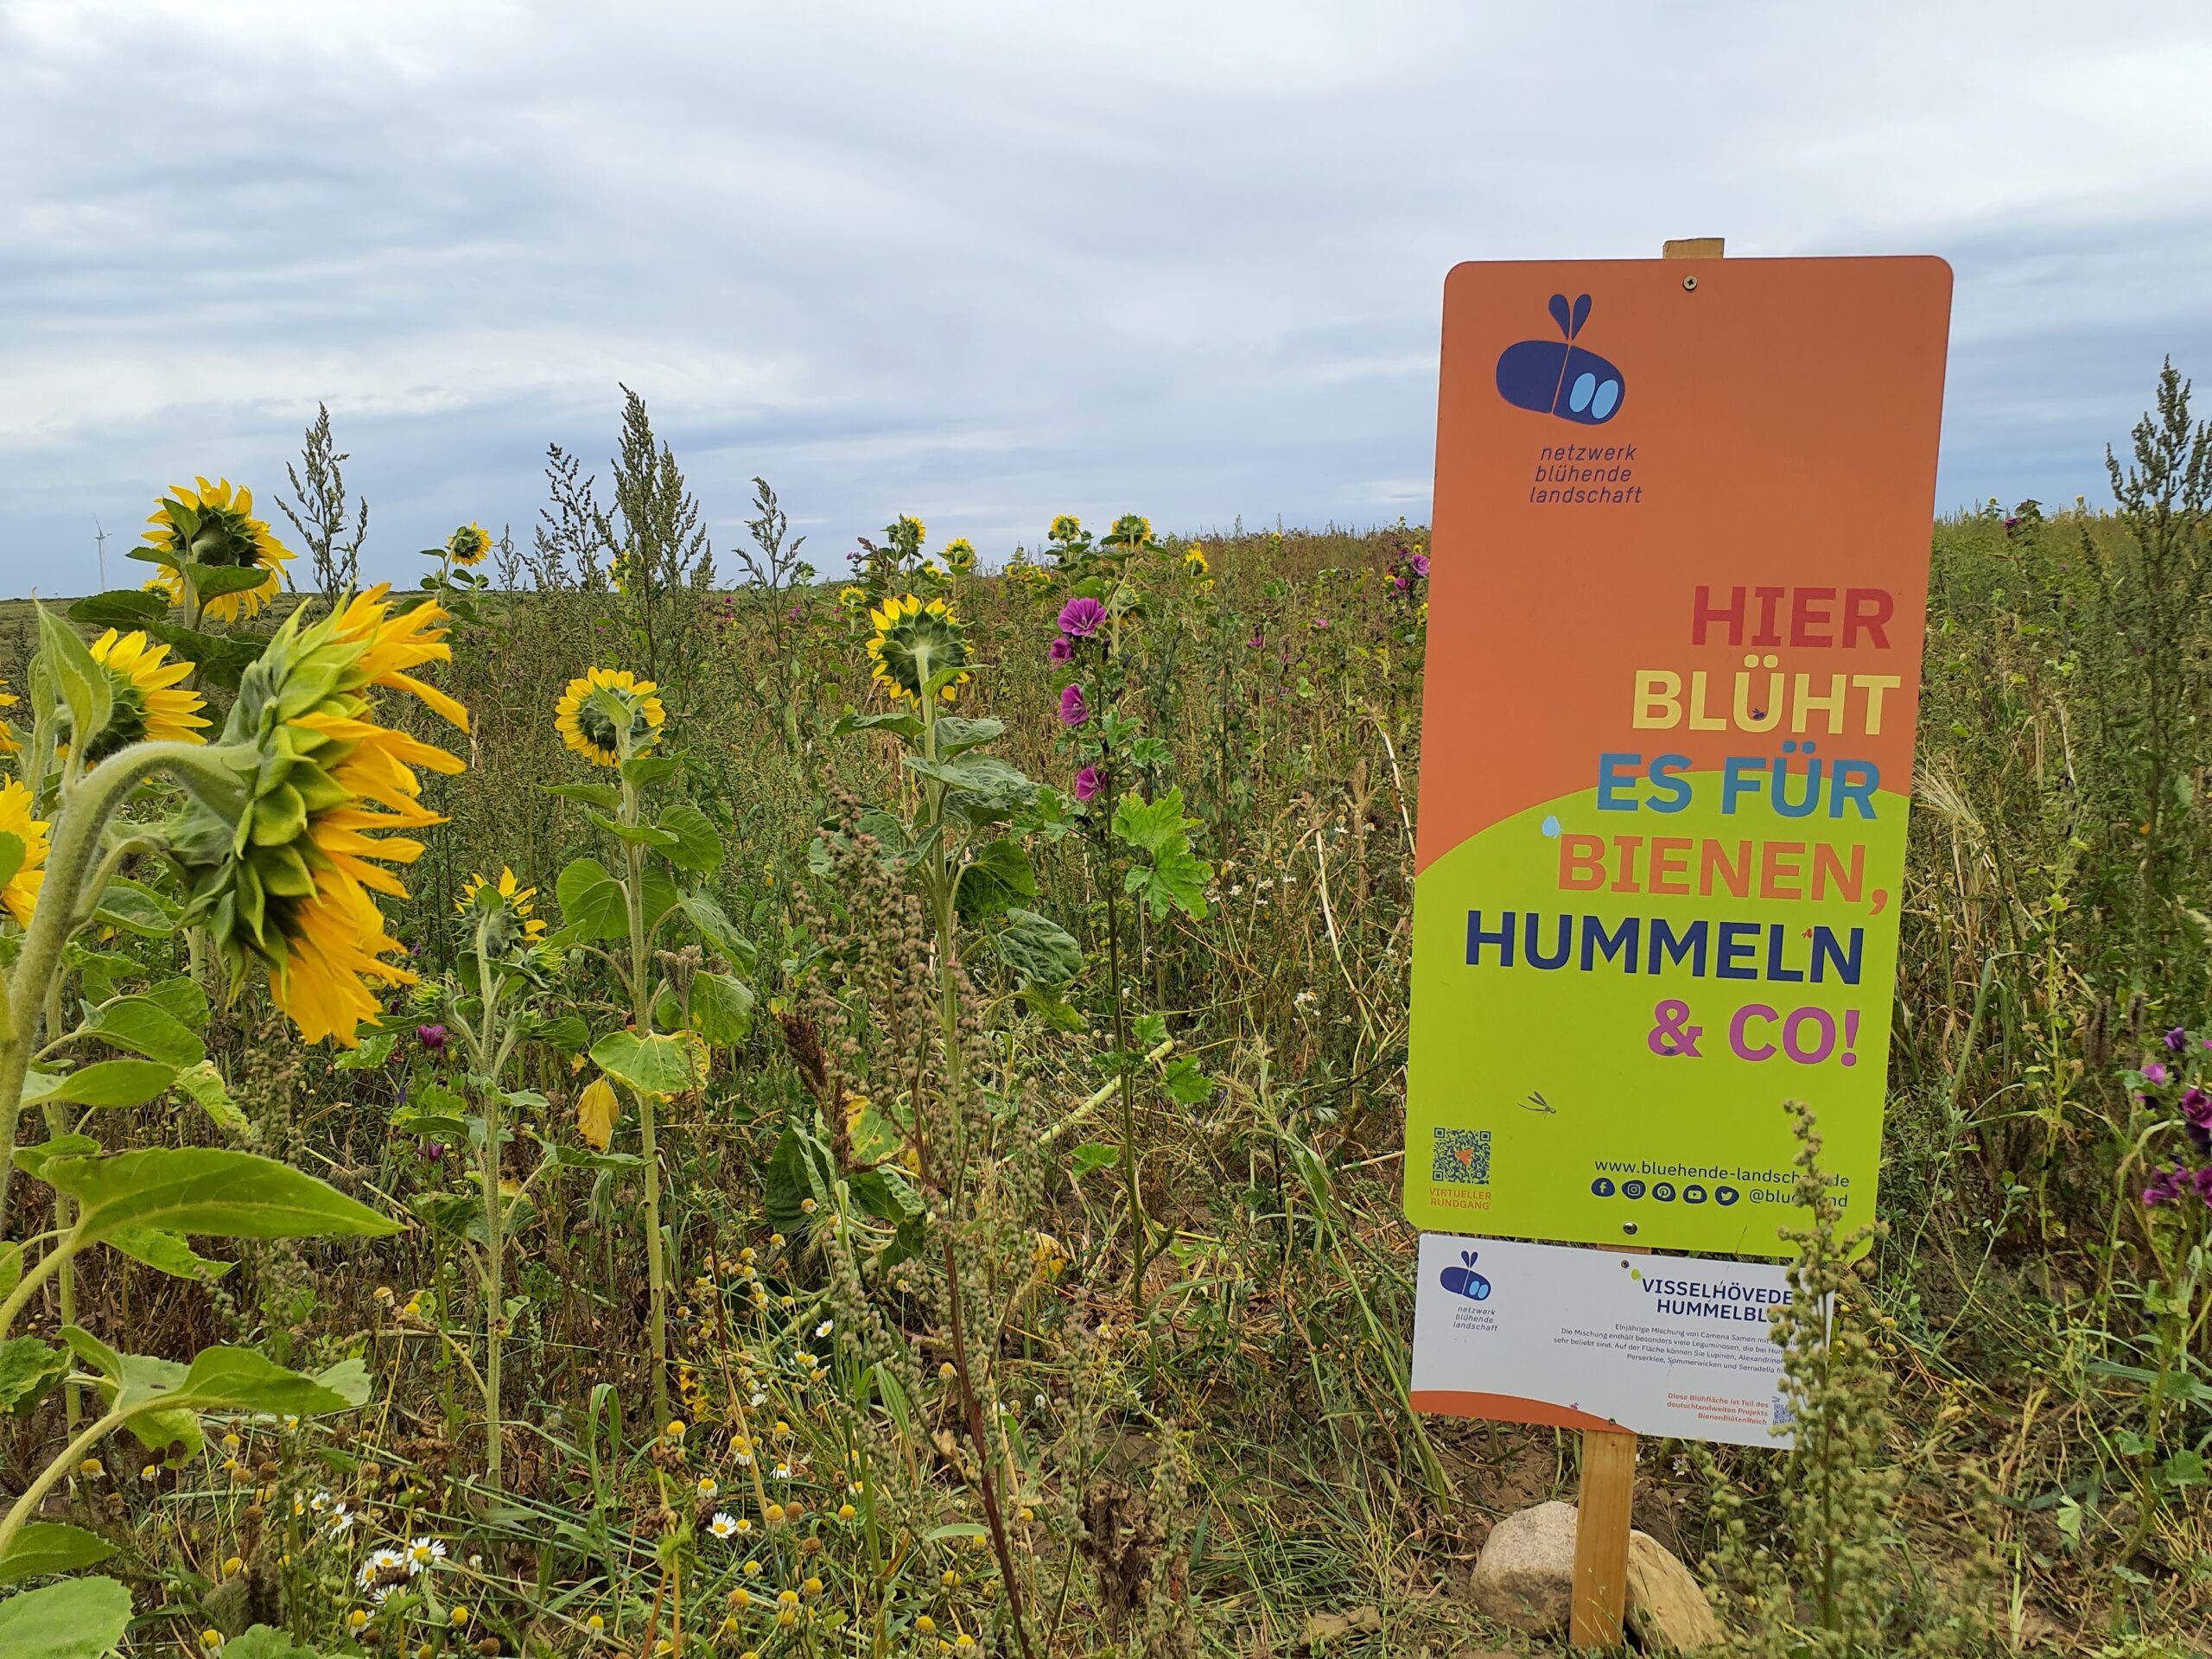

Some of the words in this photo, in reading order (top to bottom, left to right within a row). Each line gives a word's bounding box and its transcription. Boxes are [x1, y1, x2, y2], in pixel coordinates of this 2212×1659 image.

[1540, 443, 1637, 461] netzwerk
[1535, 465, 1632, 482] blühende
[1529, 486, 1643, 504] landschaft
[1691, 586, 1895, 650] HIER
[1632, 654, 1902, 735] BLÜHT
[1597, 753, 1693, 814] ES
[1720, 741, 1881, 820] FÜR
[1558, 833, 1888, 916] BIENEN,
[1465, 910, 1865, 985] HUMMELN
[1647, 999, 1704, 1058] &
[1729, 1004, 1860, 1067] CO!
[1429, 1187, 1492, 1200] VIRTUELLER
[1430, 1198, 1490, 1211] RUNDGANG
[1642, 1278, 1793, 1305] VISSELHÖVEDE
[1455, 1313, 1494, 1324] blühende
[1457, 1306, 1496, 1315] netzwerk
[1453, 1321, 1498, 1332] landschaft
[1615, 1323, 1649, 1334] Einjährige
[1651, 1327, 1685, 1338] Mischung
[1700, 1332, 1730, 1340] Camena
[1574, 1329, 1607, 1339] Mischung
[1609, 1332, 1634, 1341] enthält
[1636, 1335, 1672, 1344] besonders
[1692, 1340, 1741, 1351] Leguminosen,
[1571, 1338, 1594, 1347] beliebt
[1642, 1344, 1665, 1354] Fläche
[1667, 1347, 1693, 1356] können
[1707, 1351, 1737, 1361] Lupinen,
[1626, 1353, 1666, 1363] Perserklee,
[1668, 1357, 1722, 1368] Sommerwicken
[1738, 1363, 1775, 1374] Serradella
[1689, 1395, 1729, 1405] Blühfläche
[1666, 1402, 1736, 1414] deutschlandweiten
[1738, 1408, 1768, 1417] Projekts
[1697, 1412, 1767, 1425] BienenBlütenReich
